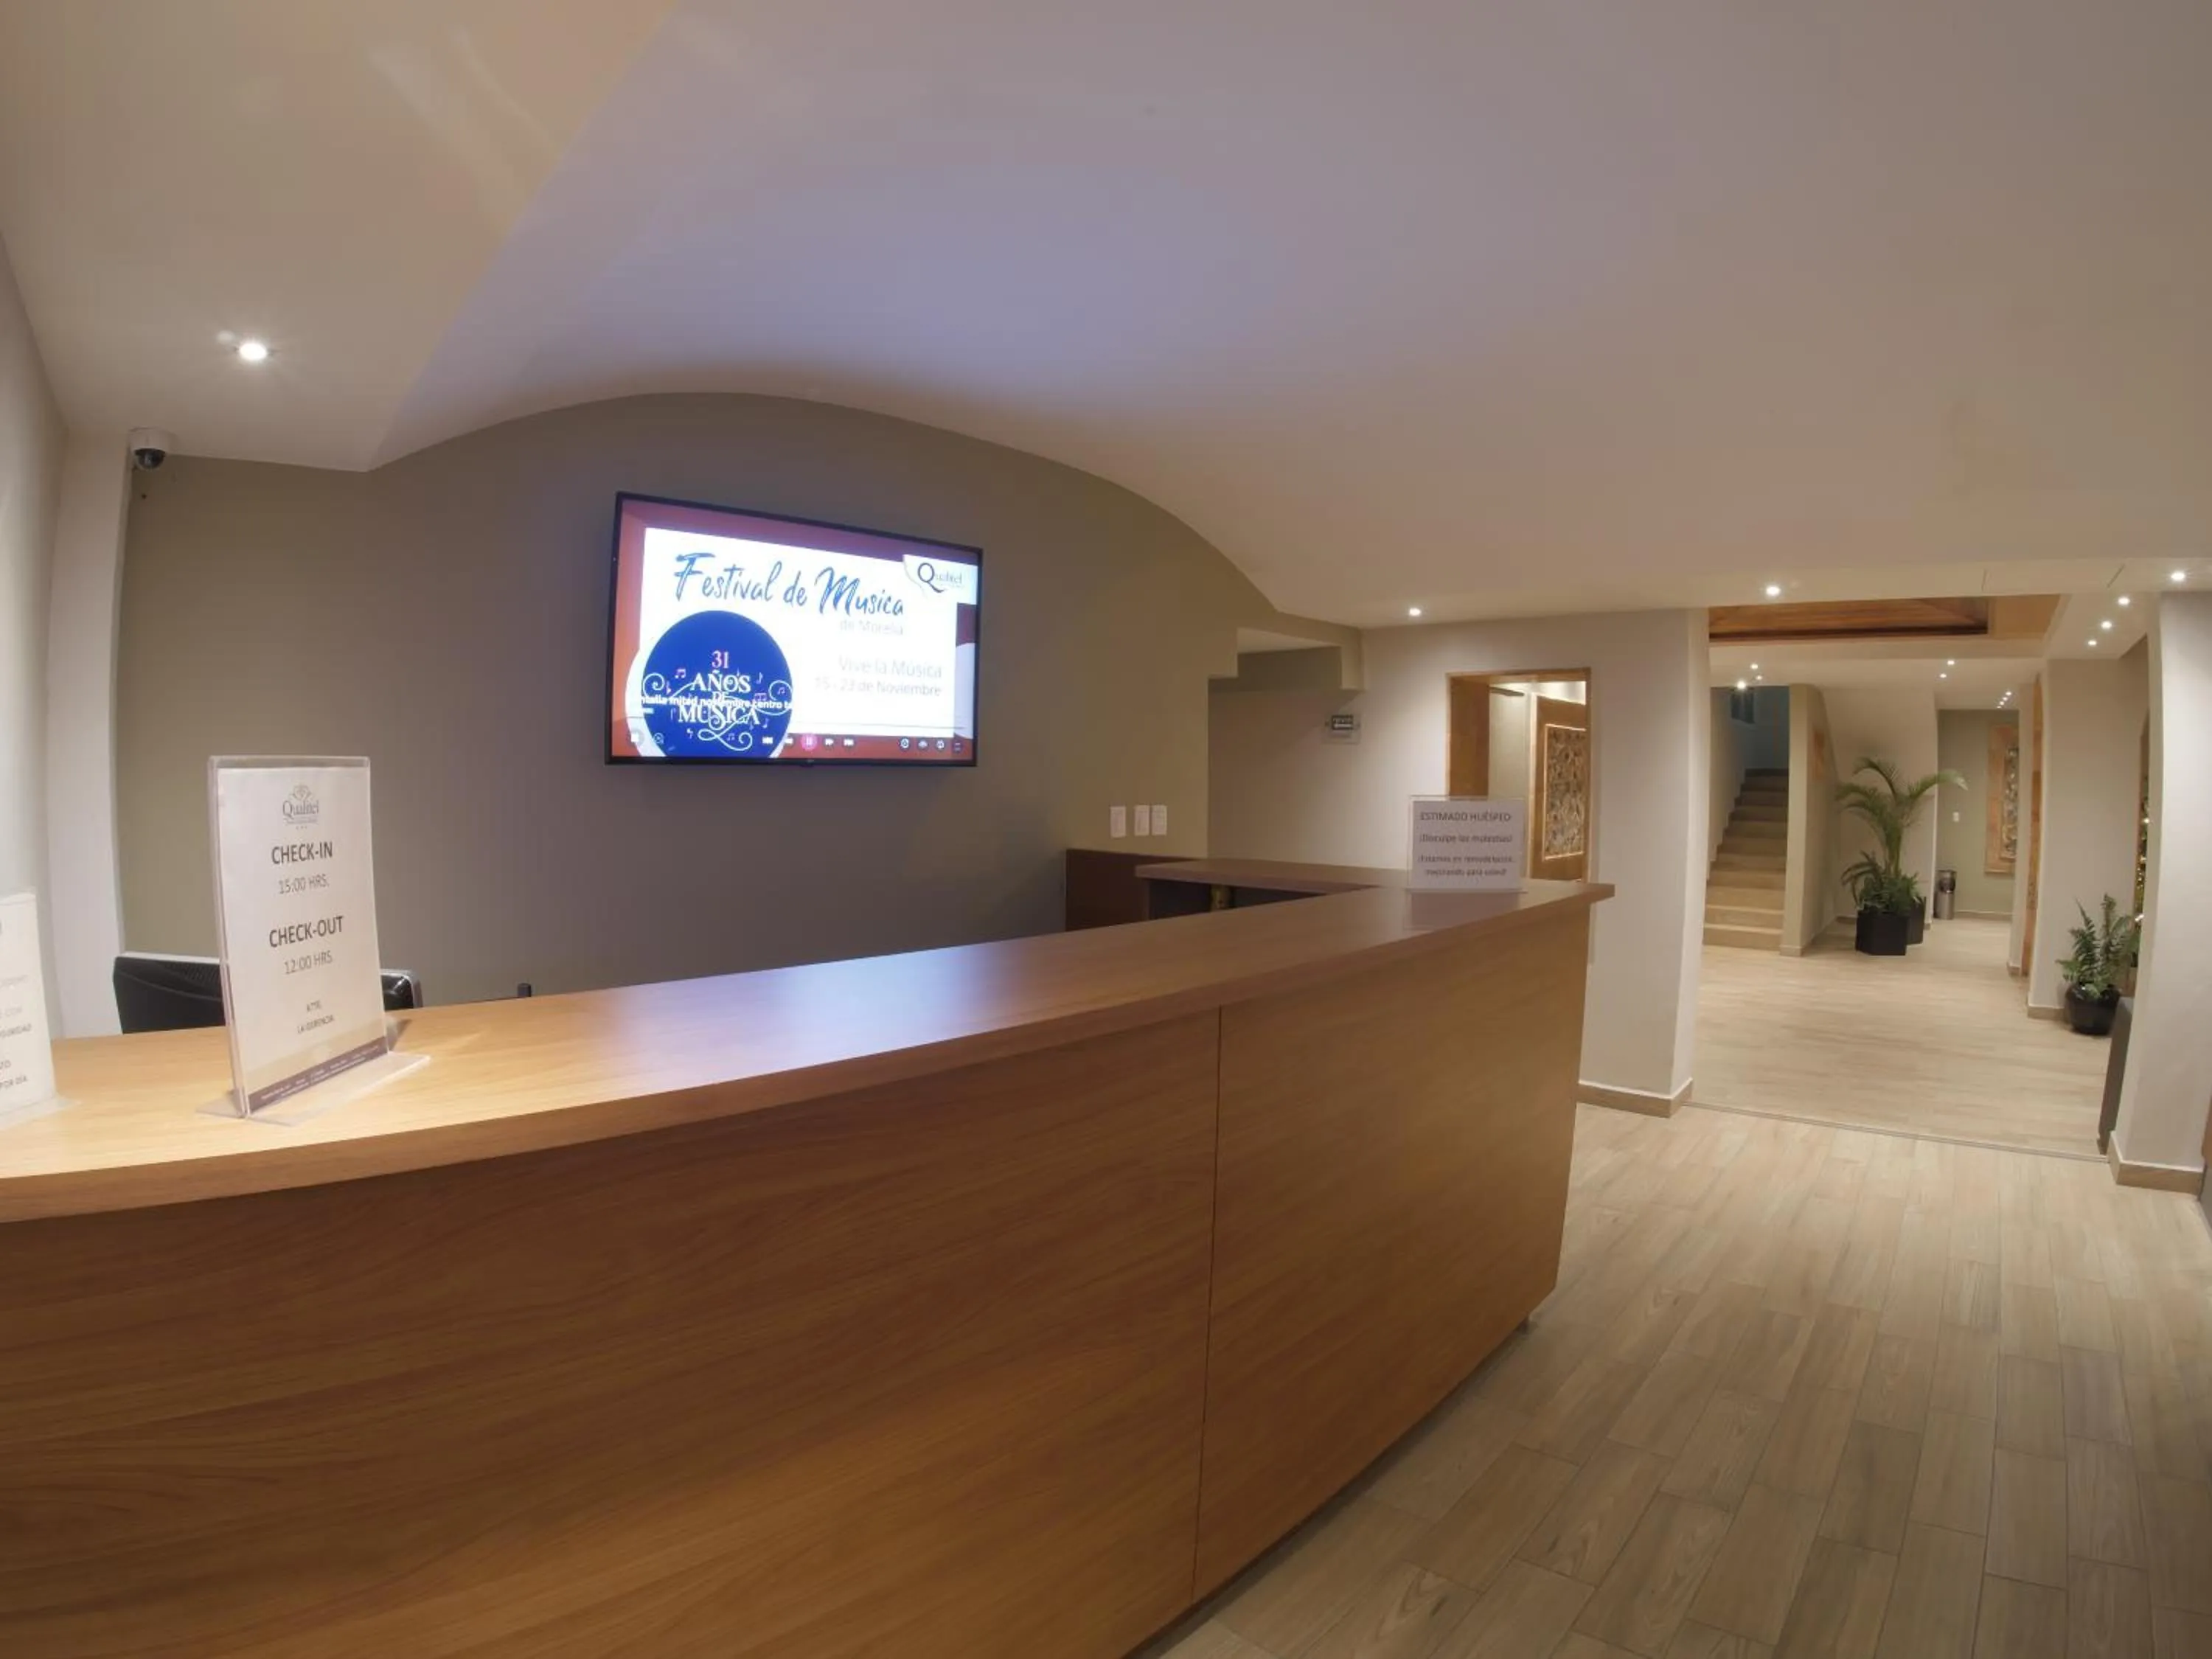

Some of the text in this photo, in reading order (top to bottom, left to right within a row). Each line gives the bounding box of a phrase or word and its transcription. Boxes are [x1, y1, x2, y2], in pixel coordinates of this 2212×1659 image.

[674, 553, 904, 616] Festival de Musica
[712, 650, 729, 669] 31
[690, 670, 751, 693] AÑOS
[858, 680, 874, 692] de
[877, 680, 942, 697] Noviembre
[1420, 812, 1468, 821] ESTIMADO
[271, 841, 333, 865] CHECK-IN
[278, 877, 307, 894] 15:00
[269, 916, 344, 947] CHECK-OUT
[284, 955, 312, 974] 12:00
